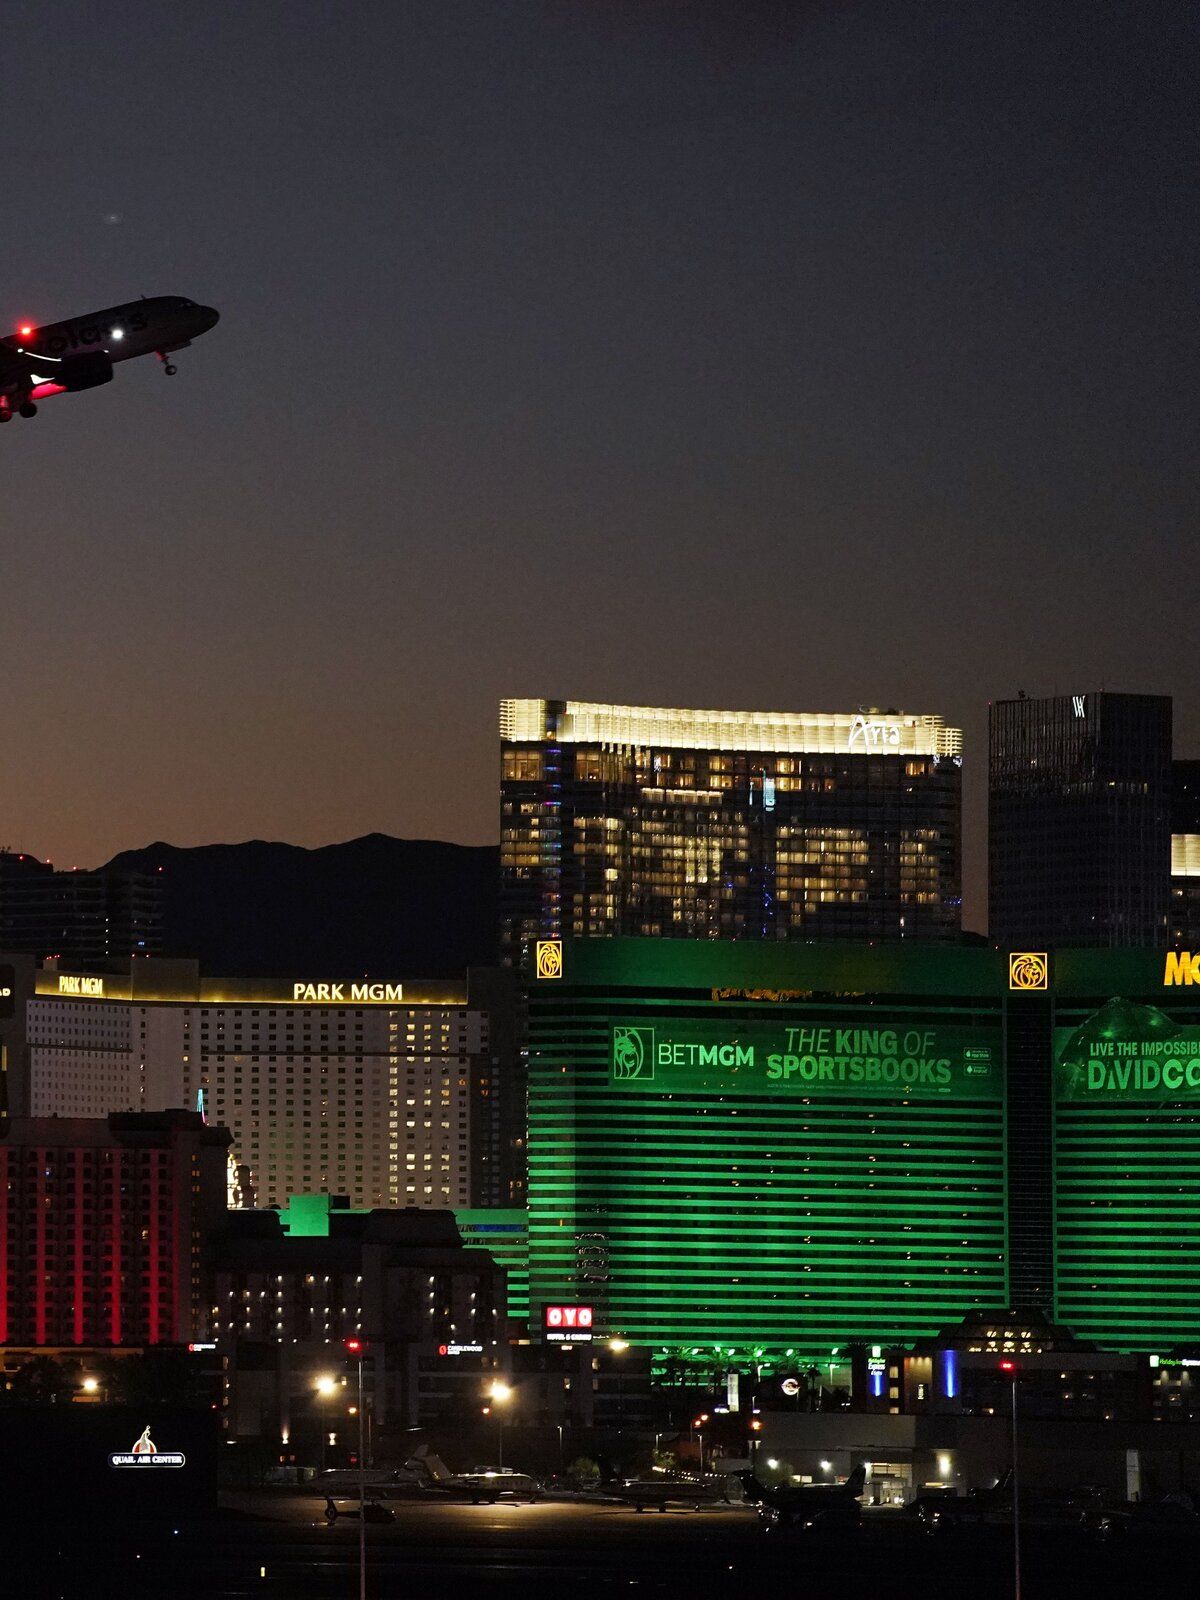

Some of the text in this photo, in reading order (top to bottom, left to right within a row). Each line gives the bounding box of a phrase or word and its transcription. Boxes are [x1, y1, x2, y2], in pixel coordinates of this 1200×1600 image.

[59, 975, 103, 995] PARK MGM
[292, 983, 403, 1001] PARK MGM
[785, 1028, 936, 1056] THE KING OF
[1090, 1042, 1114, 1057] LIVE
[1117, 1042, 1138, 1056] THE
[658, 1043, 754, 1067] BETMGM
[767, 1054, 952, 1084] SPORTSBOOKS
[549, 1308, 592, 1326] OYO
[112, 1455, 182, 1466] QUAIL AIR CENTER
